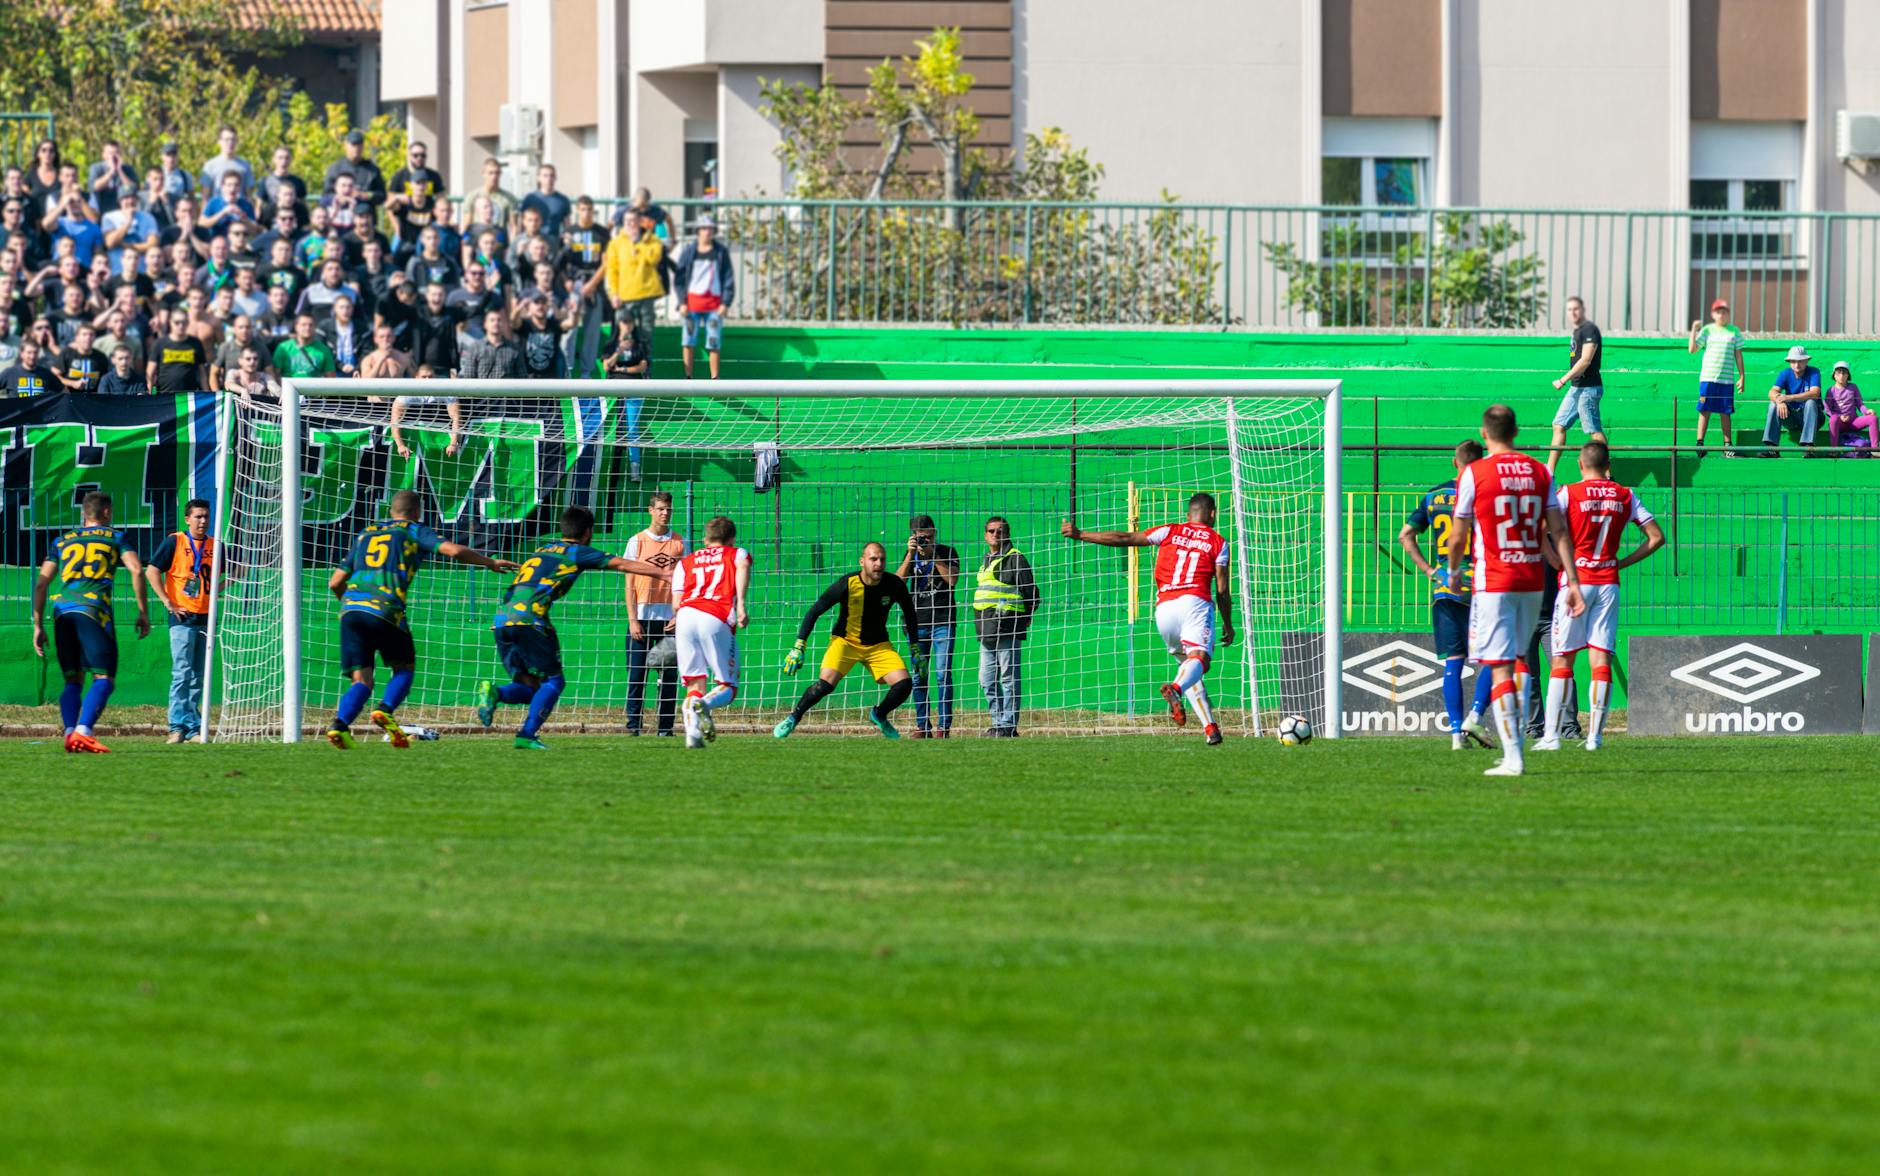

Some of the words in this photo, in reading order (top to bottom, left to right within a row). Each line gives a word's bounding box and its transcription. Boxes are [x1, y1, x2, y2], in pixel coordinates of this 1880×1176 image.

[1495, 460, 1534, 475] mts
[1586, 486, 1618, 498] mts
[1181, 526, 1211, 540] mts
[1494, 494, 1543, 550] 23
[1590, 515, 1613, 560] 7
[61, 542, 112, 584] 25
[364, 533, 393, 568] 5
[513, 556, 543, 585] 6
[690, 563, 725, 600] 17
[1171, 548, 1201, 586] 11
[1341, 704, 1454, 732] umbro
[1685, 706, 1806, 733] umbro
